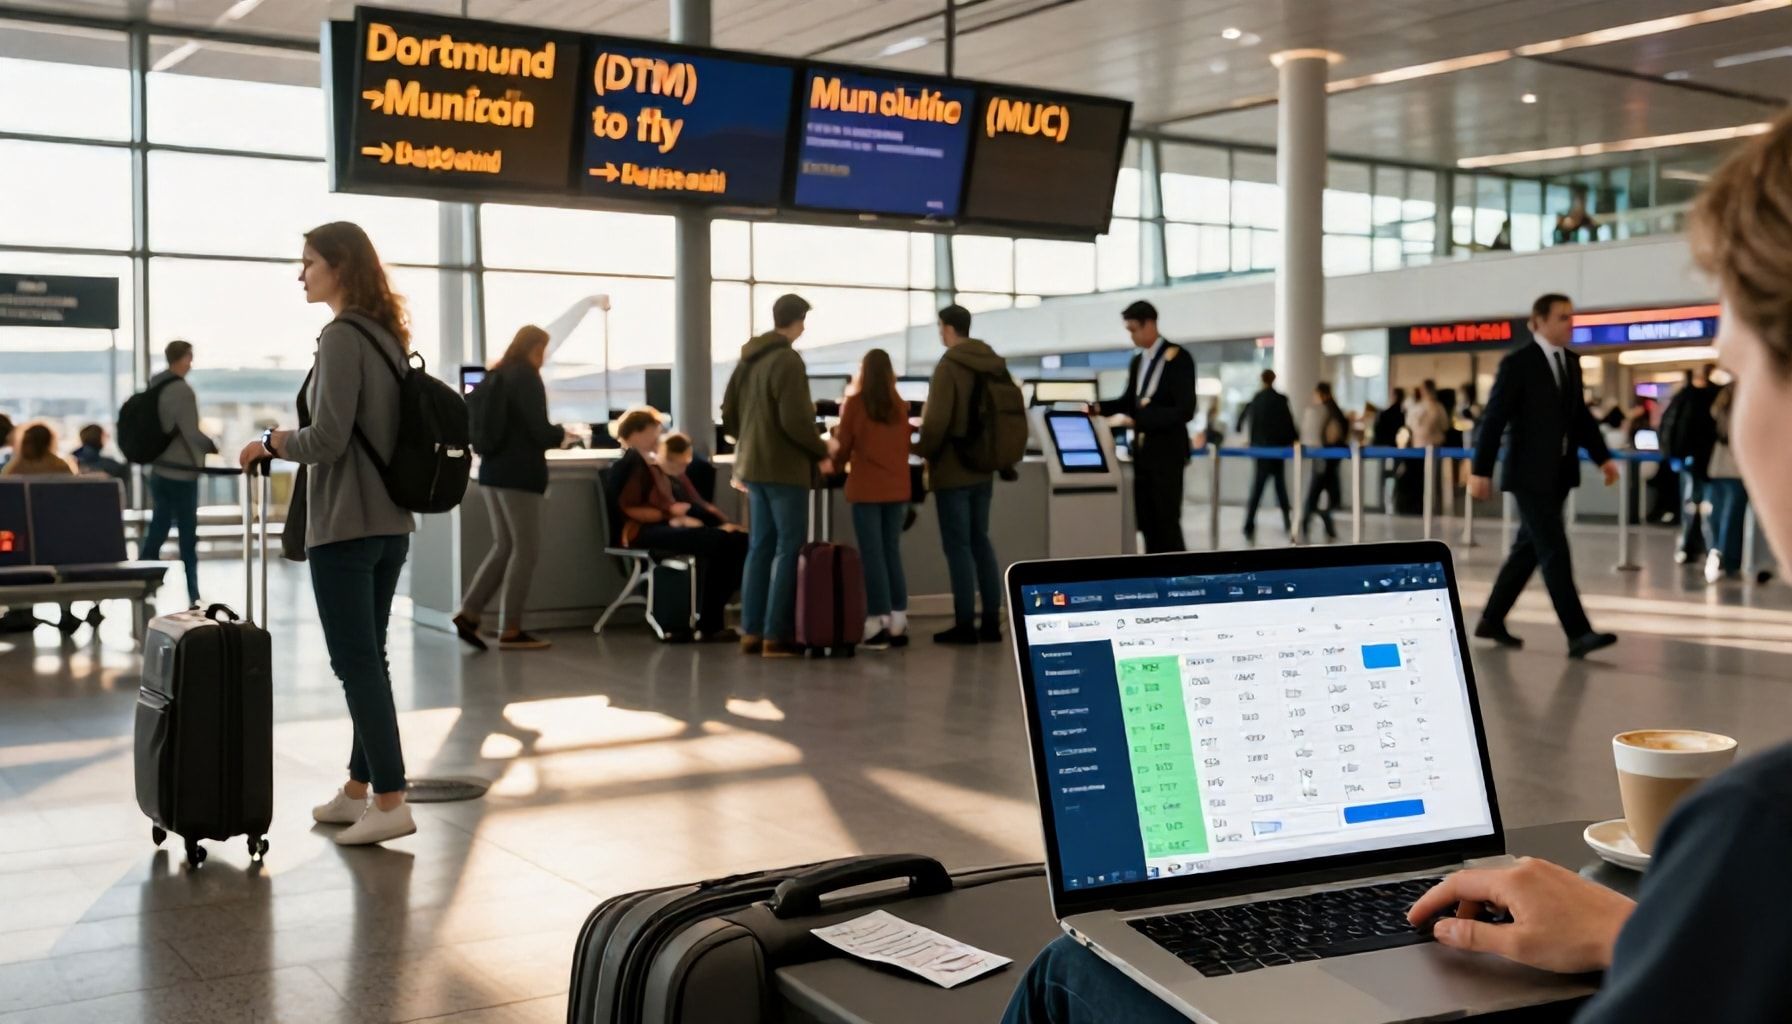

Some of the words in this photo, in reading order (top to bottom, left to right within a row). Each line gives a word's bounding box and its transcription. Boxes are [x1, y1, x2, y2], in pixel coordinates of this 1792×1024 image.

[366, 23, 556, 79] Dortmund
[594, 53, 698, 105] (DTM)
[592, 105, 628, 140] to
[986, 97, 1070, 142] (MUC)
